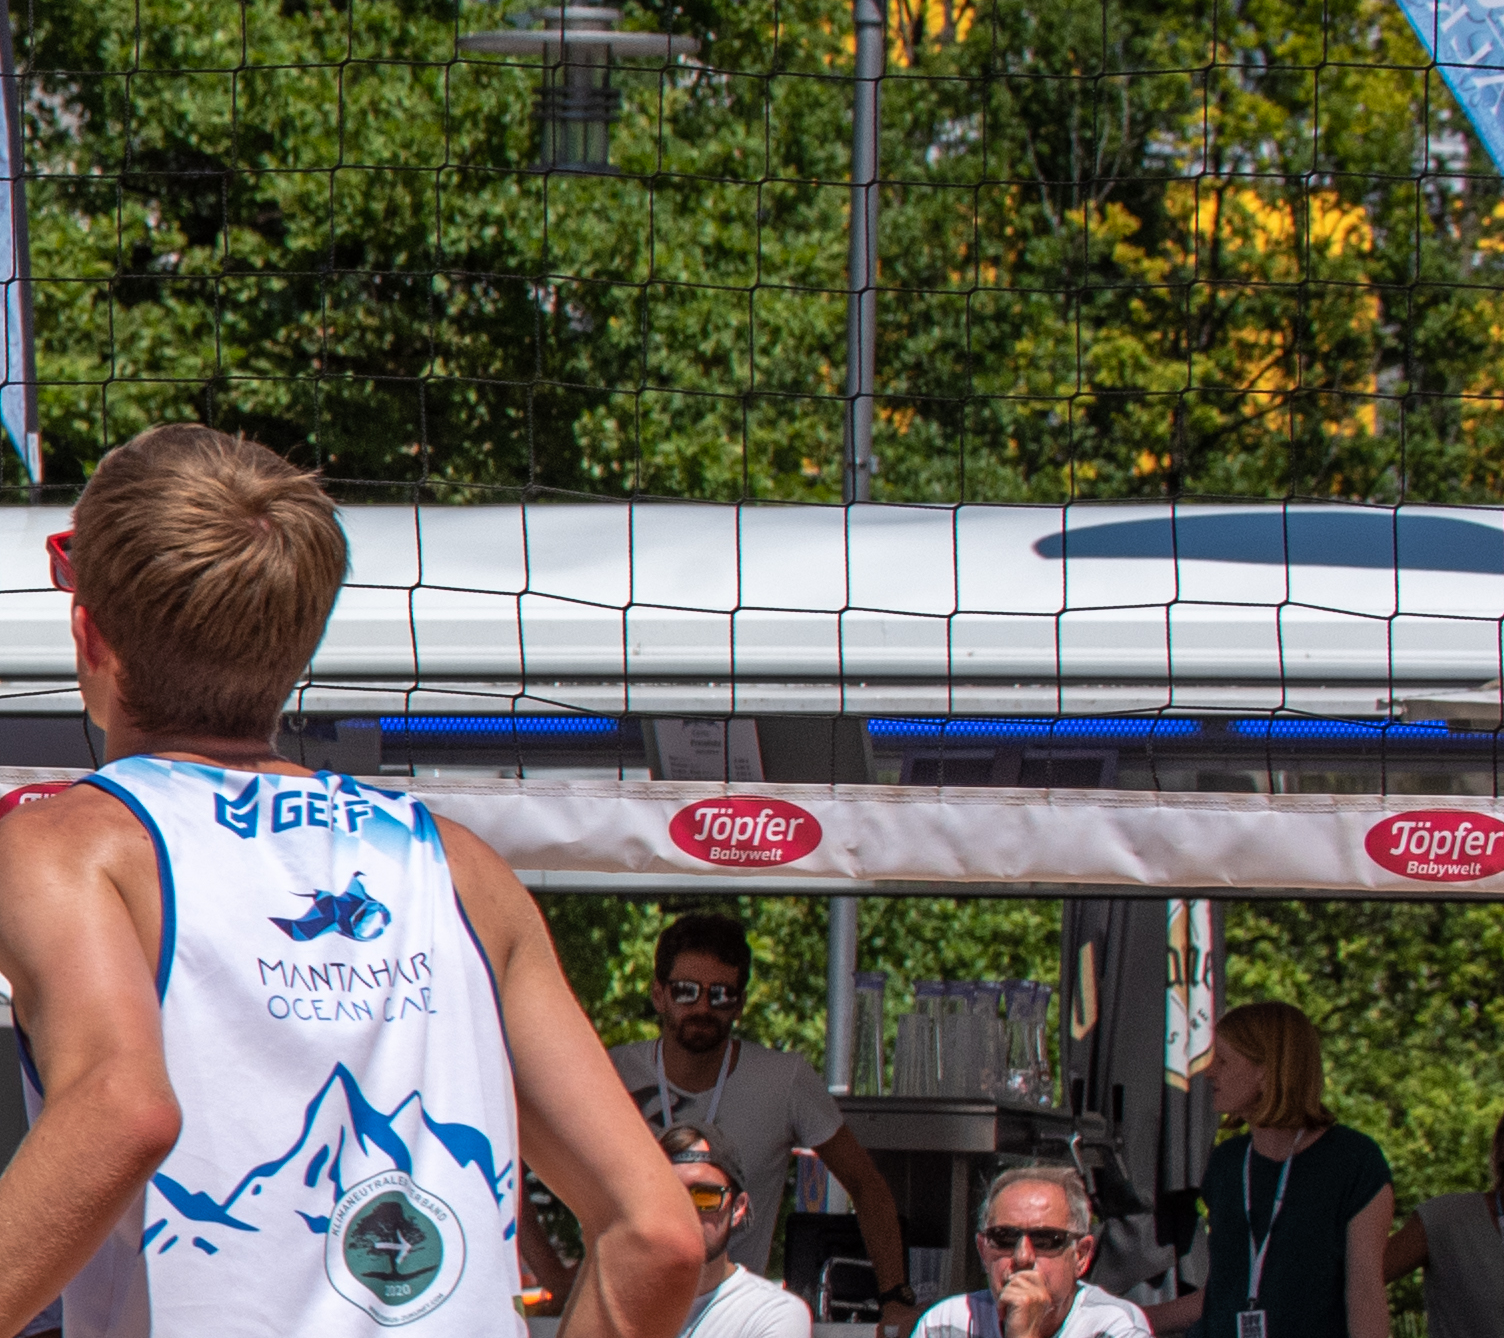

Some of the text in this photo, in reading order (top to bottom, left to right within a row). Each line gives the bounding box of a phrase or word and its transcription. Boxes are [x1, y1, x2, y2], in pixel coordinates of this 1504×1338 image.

[694, 807, 804, 846] Töpfer
[710, 847, 783, 861] Babywelt
[1406, 861, 1481, 877] Babywelt
